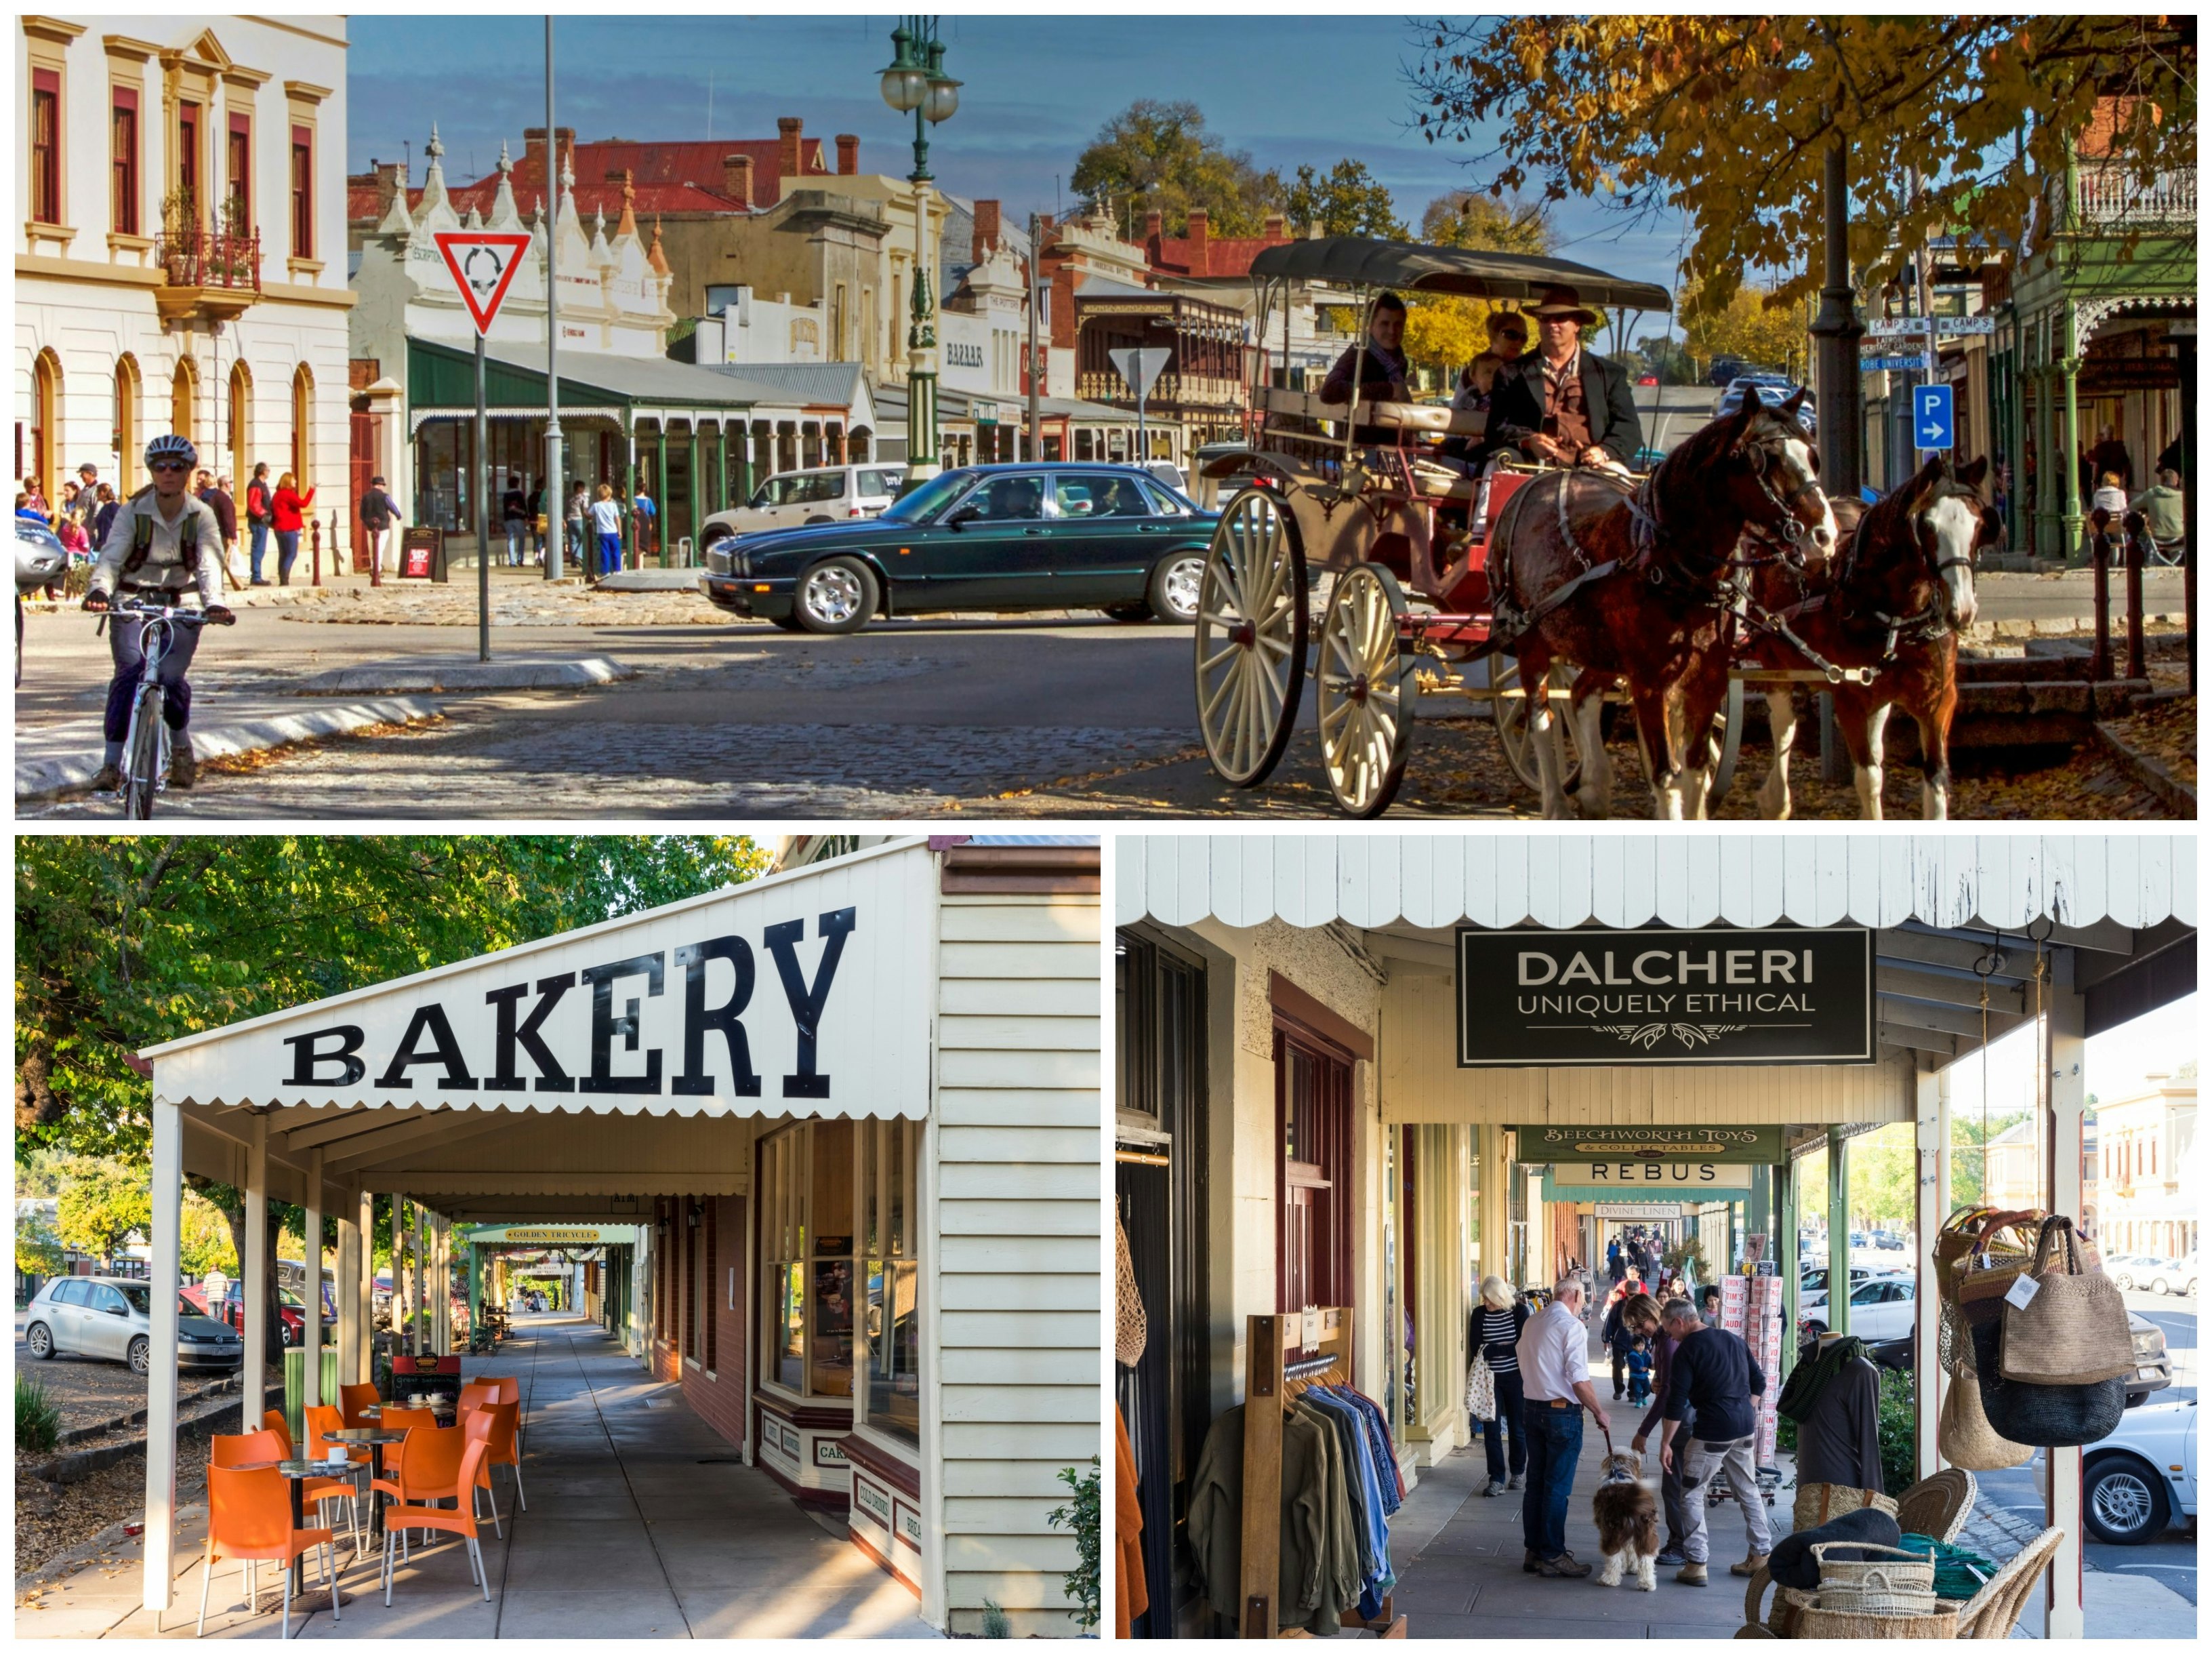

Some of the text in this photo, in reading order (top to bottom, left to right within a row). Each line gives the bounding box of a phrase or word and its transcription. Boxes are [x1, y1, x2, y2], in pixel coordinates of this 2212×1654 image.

[1874, 319, 1899, 329] CAMP
[1953, 318, 1979, 328] CAMP
[1893, 342, 1925, 351] GARDENS
[947, 342, 983, 367] BAZAAR
[1860, 358, 1924, 369] ROBE UNIVERSITY
[1925, 395, 1942, 416] P
[1518, 949, 1814, 986] DALCHERI
[282, 906, 857, 1100] BAKERY
[1518, 993, 1816, 1017] UNIQUELY ETHICAL
[1544, 1129, 1758, 1143] BEECHWORTH TOYS
[1592, 1164, 1716, 1182] REBUS
[1601, 1206, 1676, 1215] DIVINE LINEN
[1725, 1279, 1743, 1287] SIMON'S
[1726, 1292, 1744, 1301] TIM'S
[1726, 1306, 1743, 1314] TOM'S
[1725, 1320, 1742, 1328] AUDI
[820, 1447, 846, 1459] CAK
[860, 1485, 888, 1516] COLD DRINKS
[907, 1516, 921, 1540] BREA
